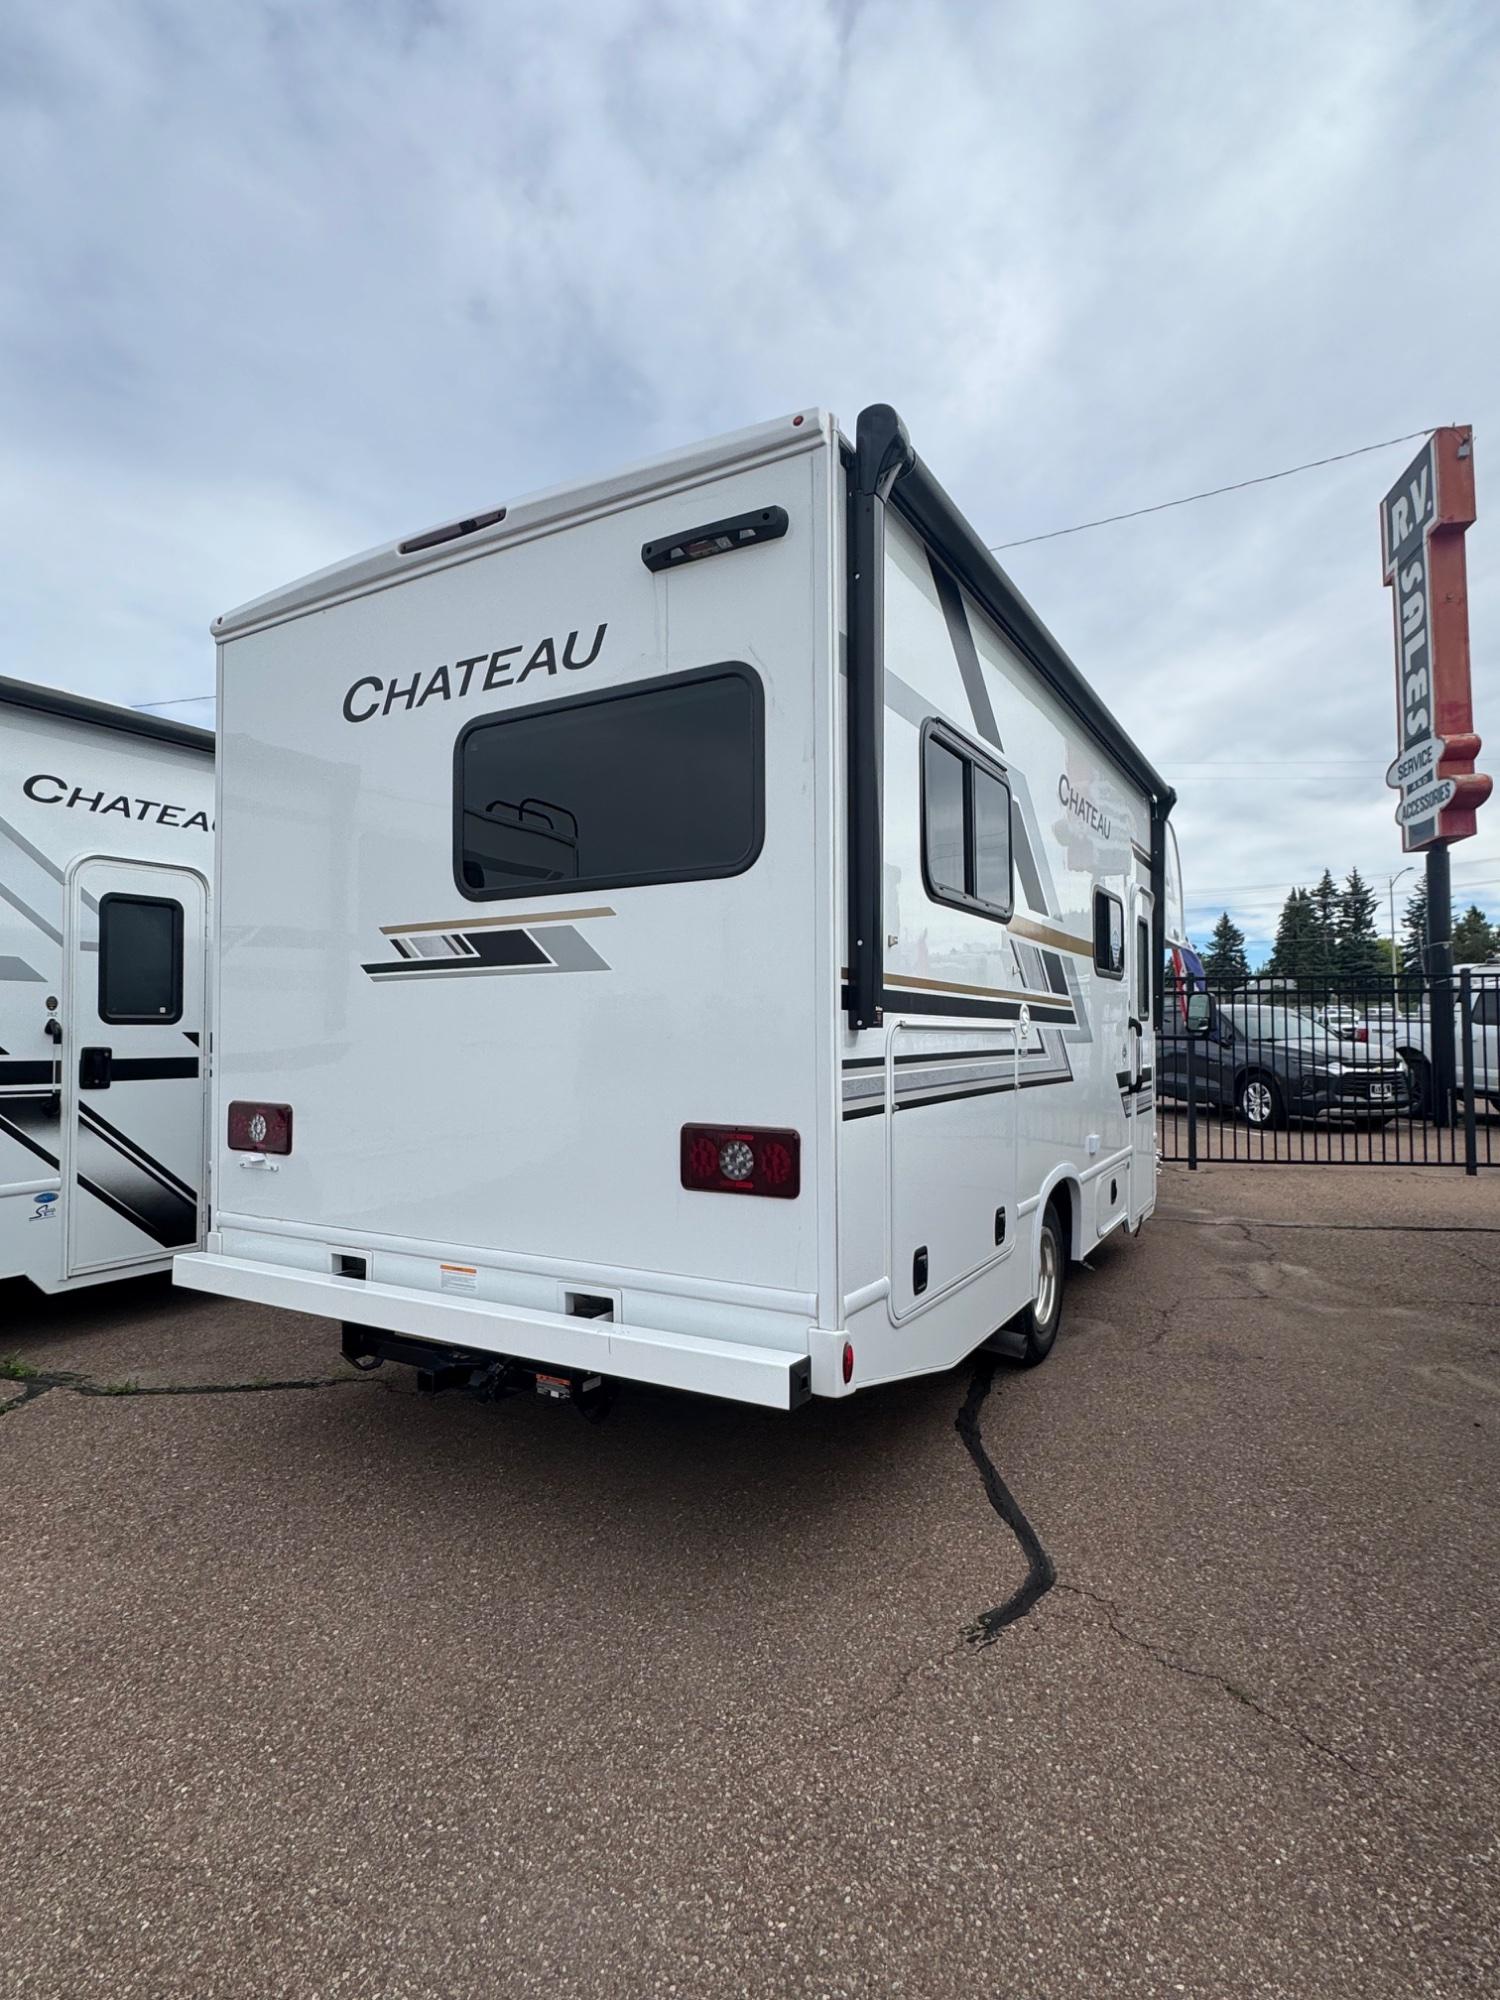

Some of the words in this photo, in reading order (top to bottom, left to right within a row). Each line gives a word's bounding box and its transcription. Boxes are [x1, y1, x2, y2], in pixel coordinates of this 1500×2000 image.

[342, 622, 609, 723] CHATEAU
[1401, 561, 1429, 736] SALES
[1397, 745, 1433, 781] SERVICE
[22, 774, 215, 832] CHATEA
[1058, 773, 1111, 840] CHATEAU
[1402, 781, 1451, 820] ACCESSORIES
